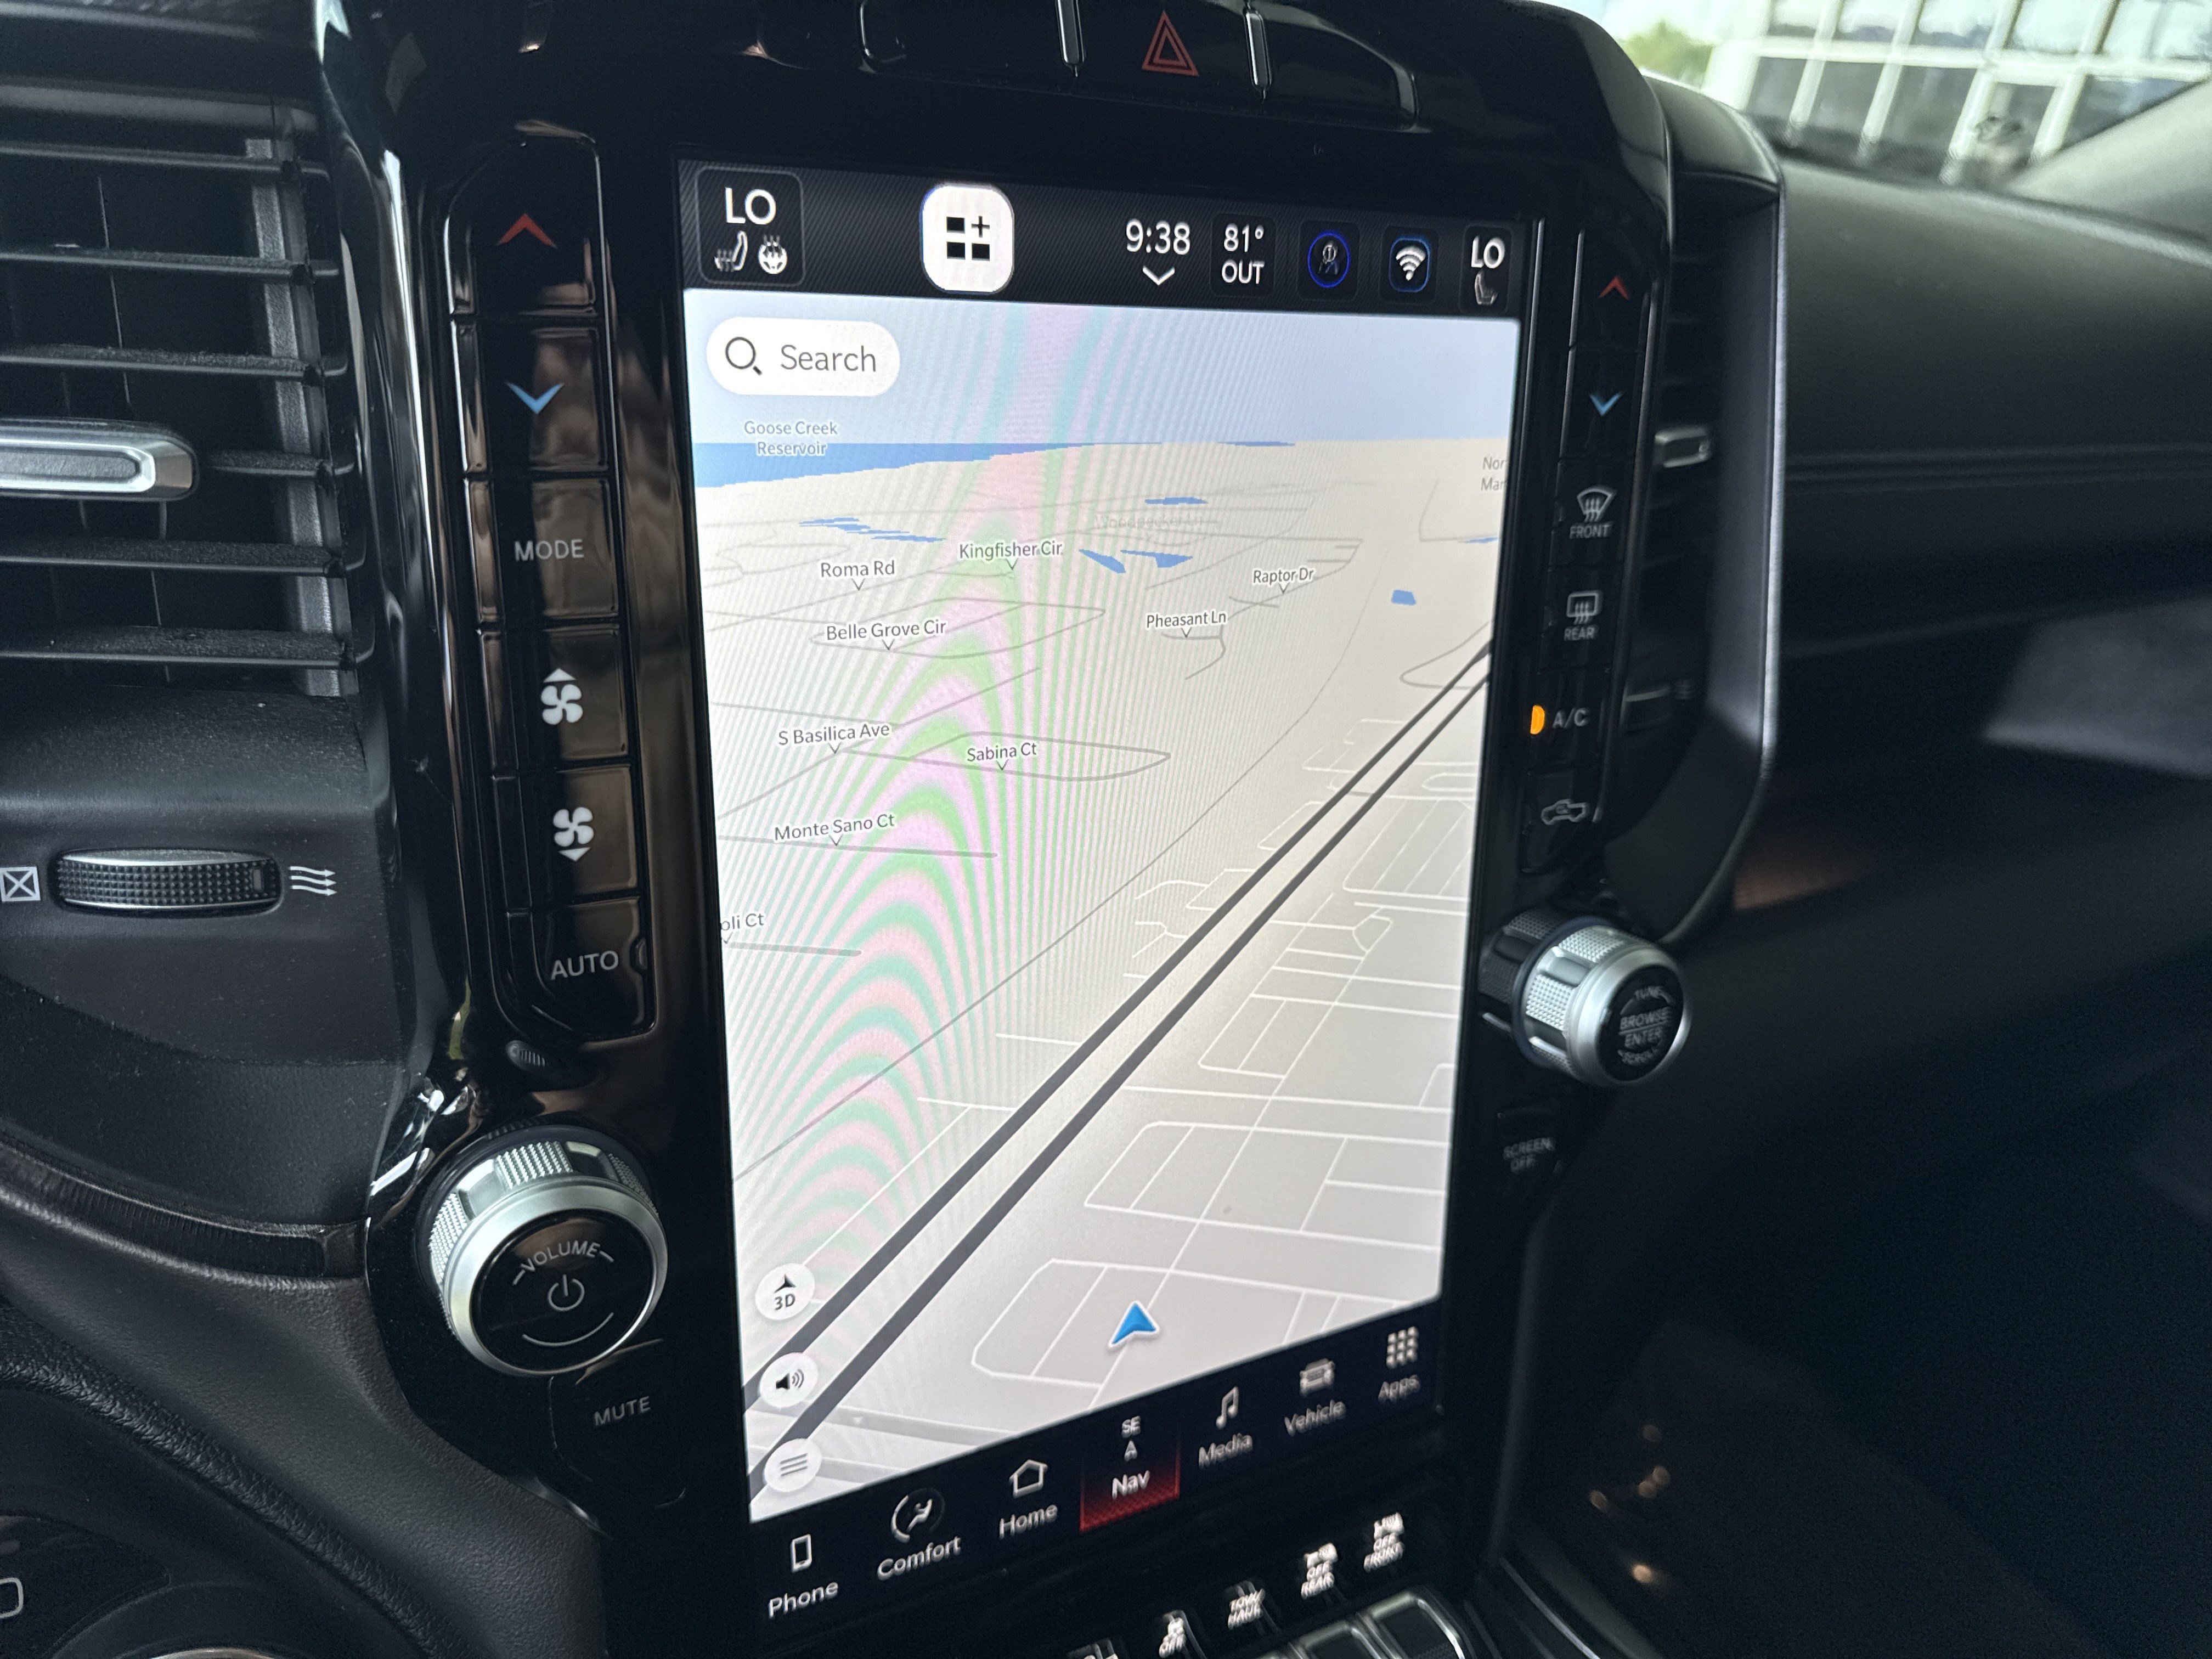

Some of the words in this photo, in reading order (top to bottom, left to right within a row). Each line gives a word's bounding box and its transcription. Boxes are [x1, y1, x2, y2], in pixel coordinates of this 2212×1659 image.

[725, 186, 777, 225] LO
[1126, 218, 1190, 255] 9:38
[1223, 223, 1264, 252] 81°
[1471, 235, 1505, 269] LO
[1221, 259, 1265, 285] OUT
[780, 345, 877, 373] Search
[744, 421, 791, 437] Goose
[795, 421, 838, 436] Creek
[757, 442, 827, 456] Reservoir
[1482, 457, 1508, 470] Nor
[1481, 477, 1506, 491] Mar
[1570, 522, 1613, 539] FRONT
[515, 539, 584, 561] MODE
[960, 543, 1037, 561] Kingfisher
[1041, 541, 1062, 555] Cir
[821, 562, 868, 578] Roma
[874, 560, 895, 575] Rd
[1253, 569, 1296, 586] Raptor
[1299, 568, 1314, 581] Dr
[827, 624, 867, 640] Belle
[871, 623, 920, 637] Grove
[924, 619, 946, 635] Cir
[1147, 613, 1207, 628] Pheasant
[1210, 611, 1227, 624] Ln
[1564, 625, 1599, 641] REAR
[1552, 708, 1589, 729] A/C
[778, 731, 788, 745] S
[794, 727, 856, 744] Basilica
[860, 724, 890, 738] Ave
[967, 746, 1017, 761] Sabina
[1020, 743, 1037, 757] Ct
[775, 823, 829, 840] Monte
[833, 818, 873, 833] Sano
[877, 814, 894, 827] Ct
[746, 913, 764, 927] Ct
[550, 950, 619, 980] AUTO
[1620, 1007, 1671, 1030] BROWSE
[1503, 1137, 1556, 1160] SCREEN
[521, 1240, 601, 1273] VOLUME
[774, 1293, 796, 1311] 3D
[1378, 1375, 1421, 1403] Apps
[594, 1396, 652, 1426] MUTE
[1284, 1400, 1346, 1436] Vehicle
[1122, 1415, 1141, 1438] SE
[1199, 1432, 1253, 1469] Media
[1111, 1470, 1150, 1499] Nav
[998, 1504, 1058, 1539] Home
[878, 1536, 962, 1581] Comfort
[769, 1582, 839, 1618] Phone
